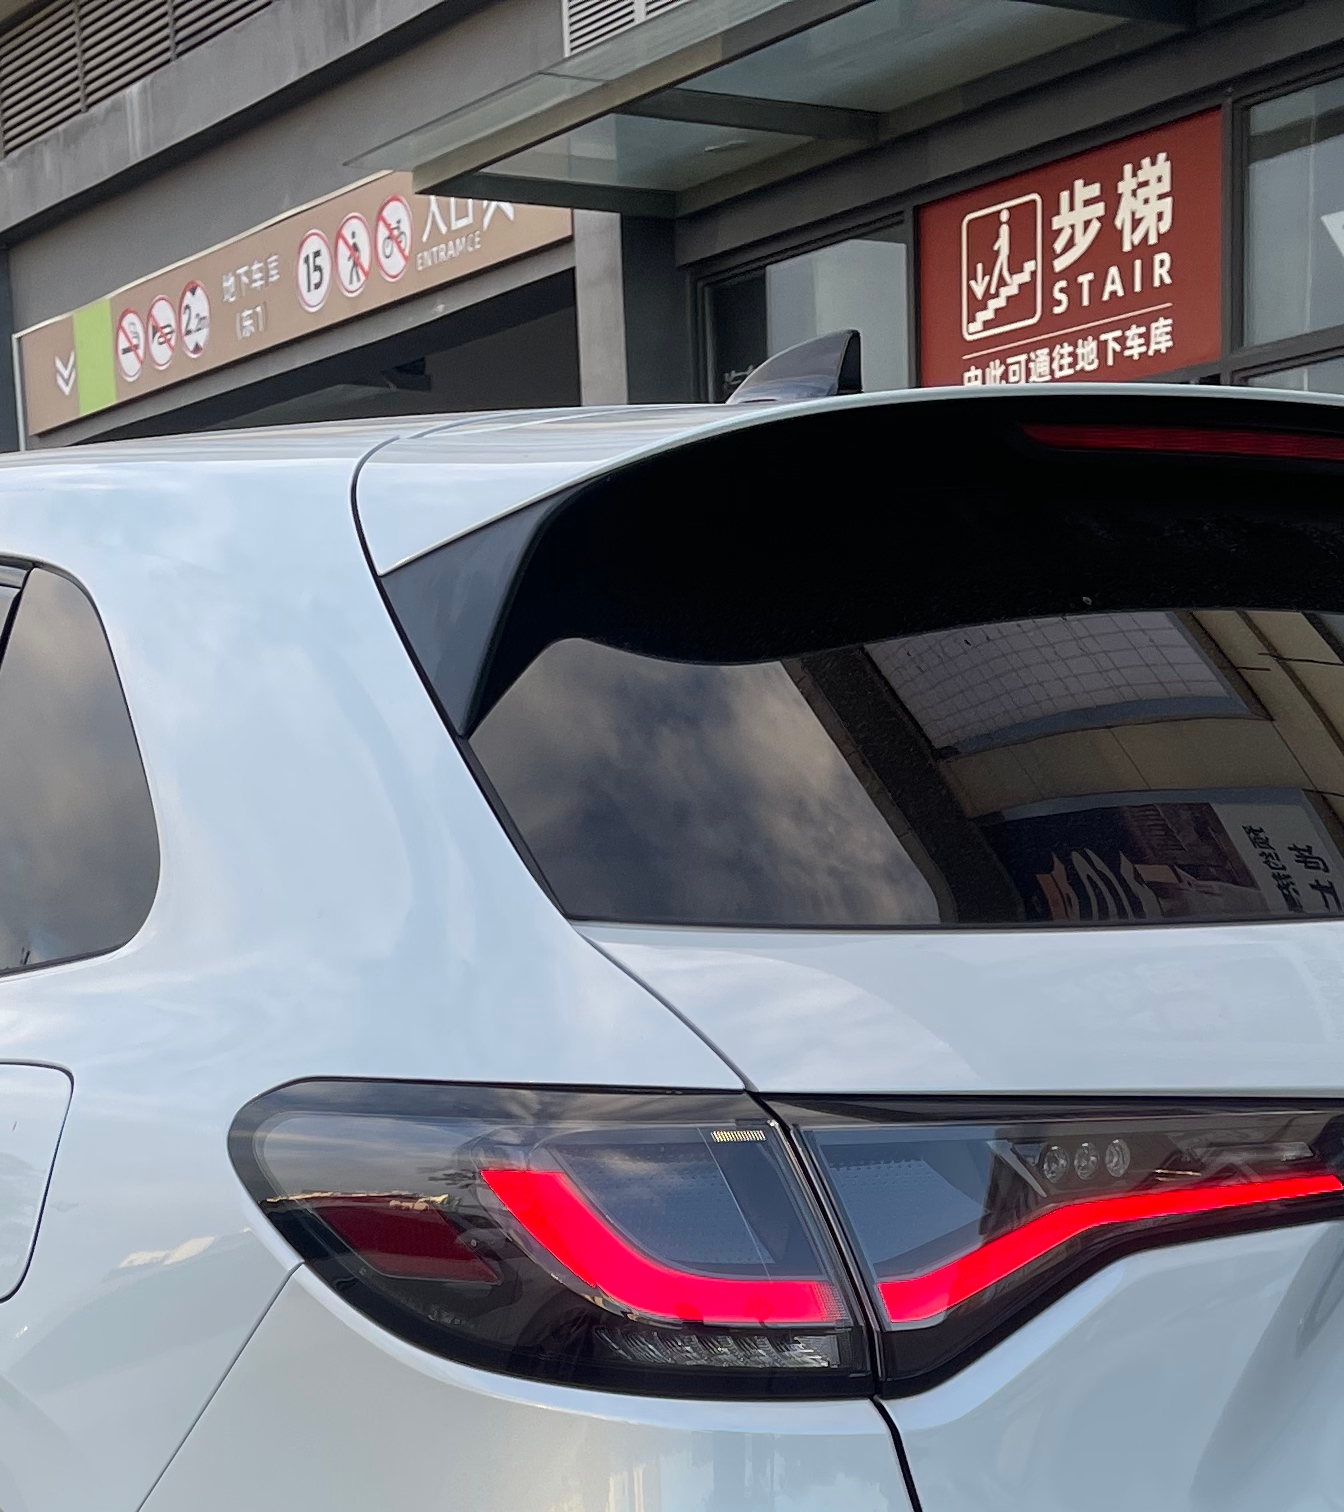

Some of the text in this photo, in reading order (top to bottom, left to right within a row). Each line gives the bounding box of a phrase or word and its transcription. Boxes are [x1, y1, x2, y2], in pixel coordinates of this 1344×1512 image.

[1051, 151, 1173, 272] 步梯
[303, 249, 324, 293] 15
[416, 230, 482, 271] ENTRANCE
[1052, 252, 1173, 314] STAIR
